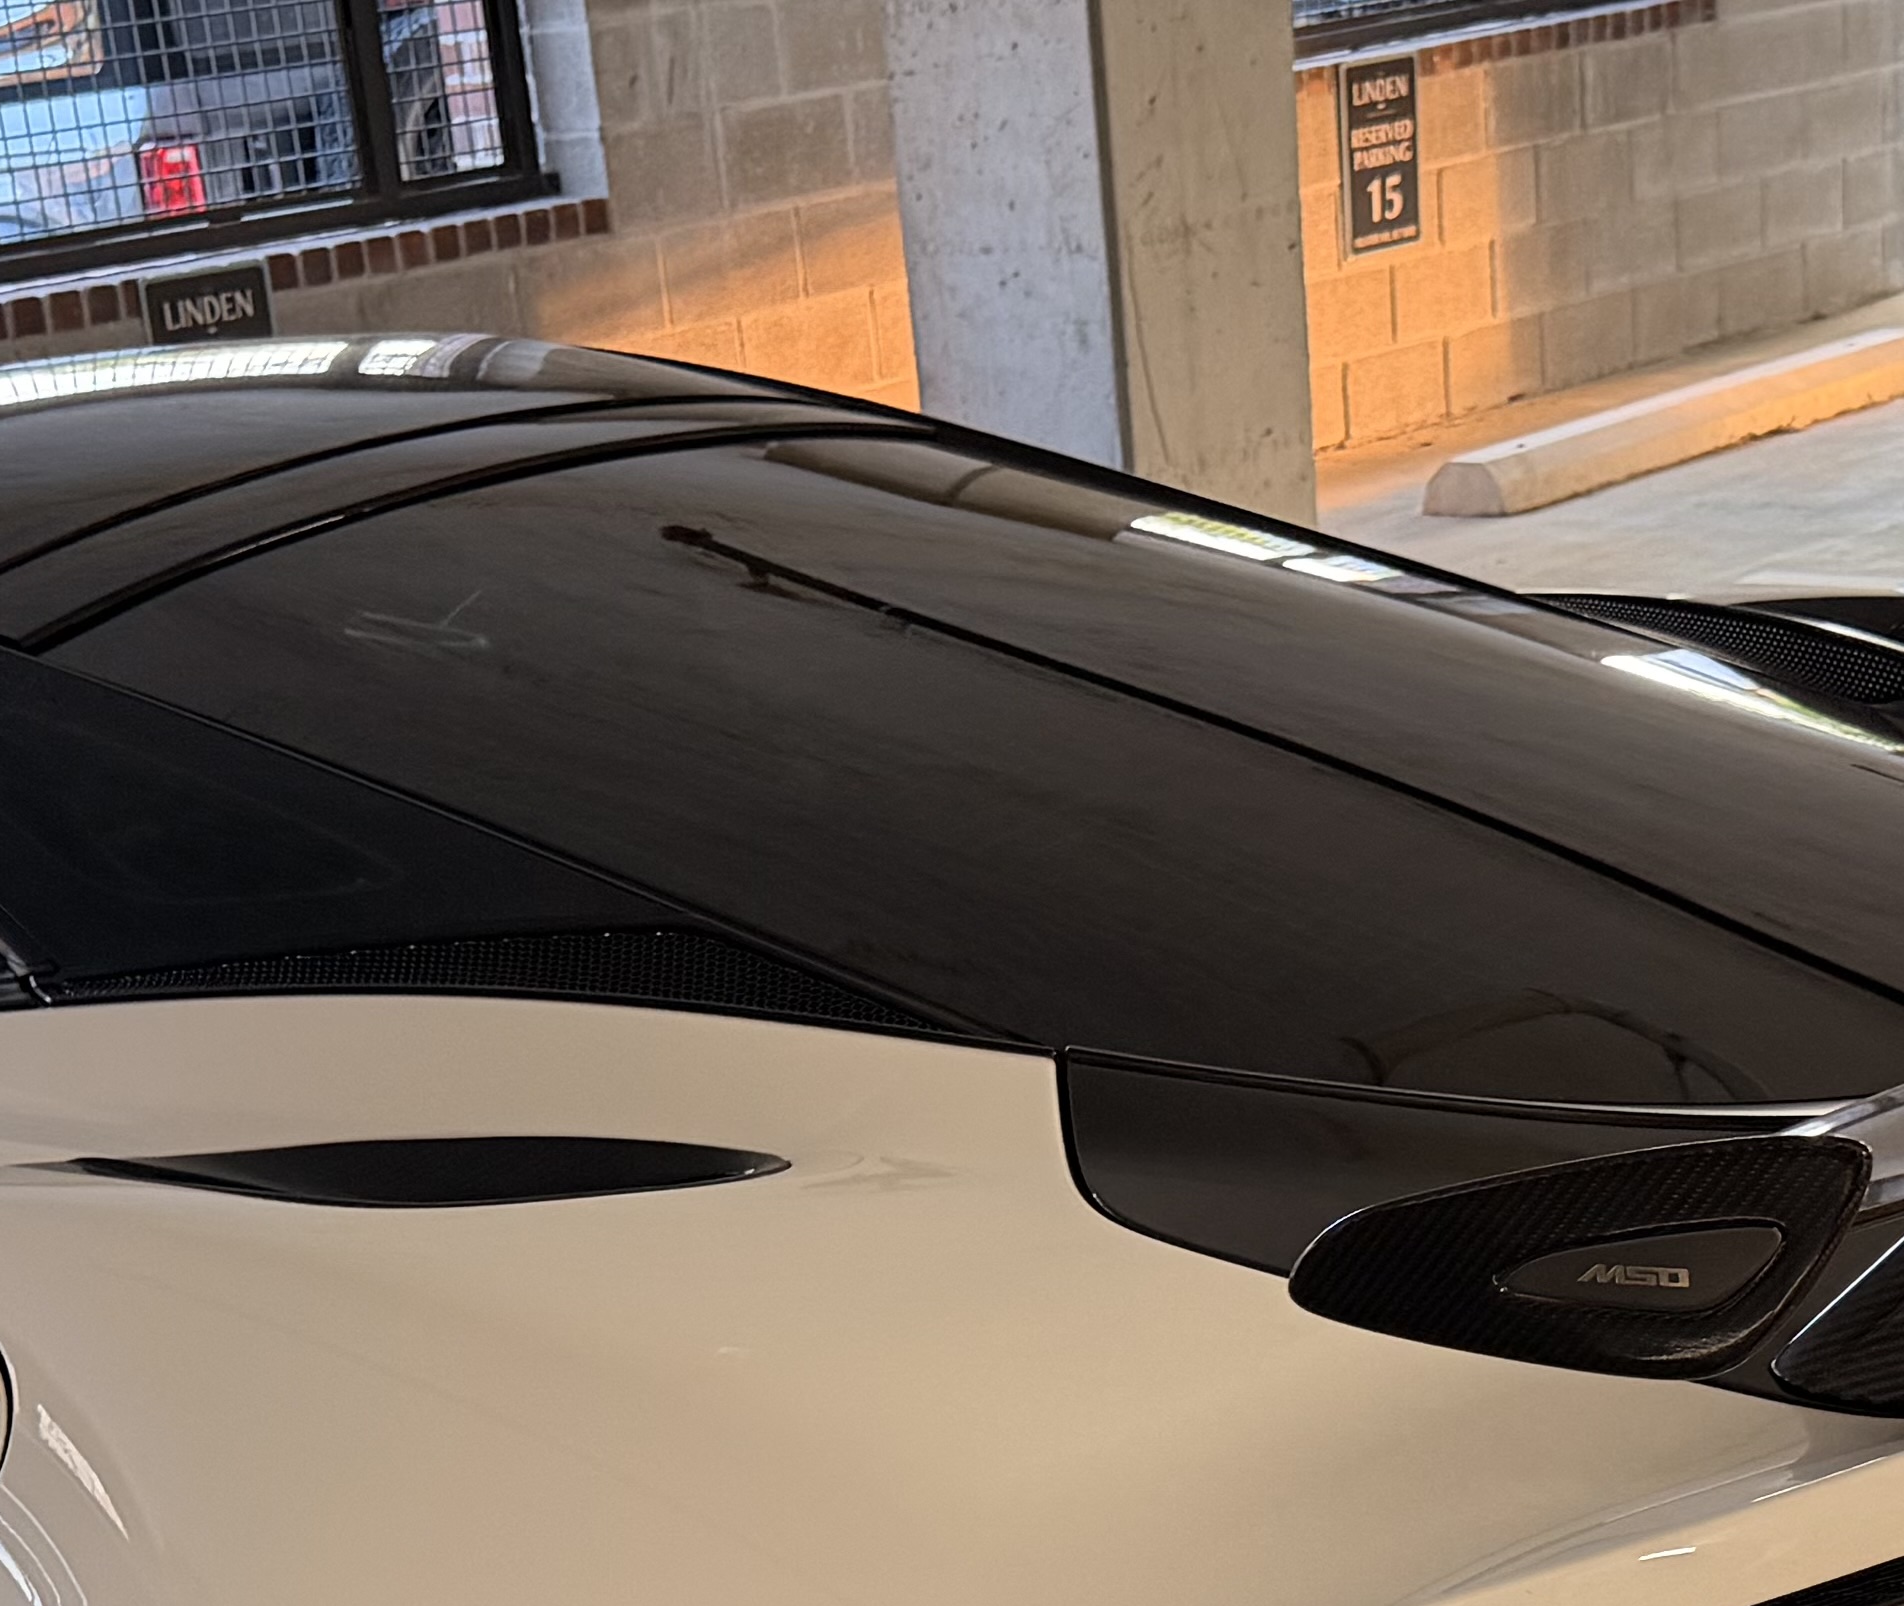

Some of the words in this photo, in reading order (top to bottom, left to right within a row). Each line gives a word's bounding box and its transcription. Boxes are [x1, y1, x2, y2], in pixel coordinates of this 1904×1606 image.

[1352, 73, 1410, 106] LINDEN
[1366, 171, 1404, 224] 15
[163, 288, 255, 331] LINDEN
